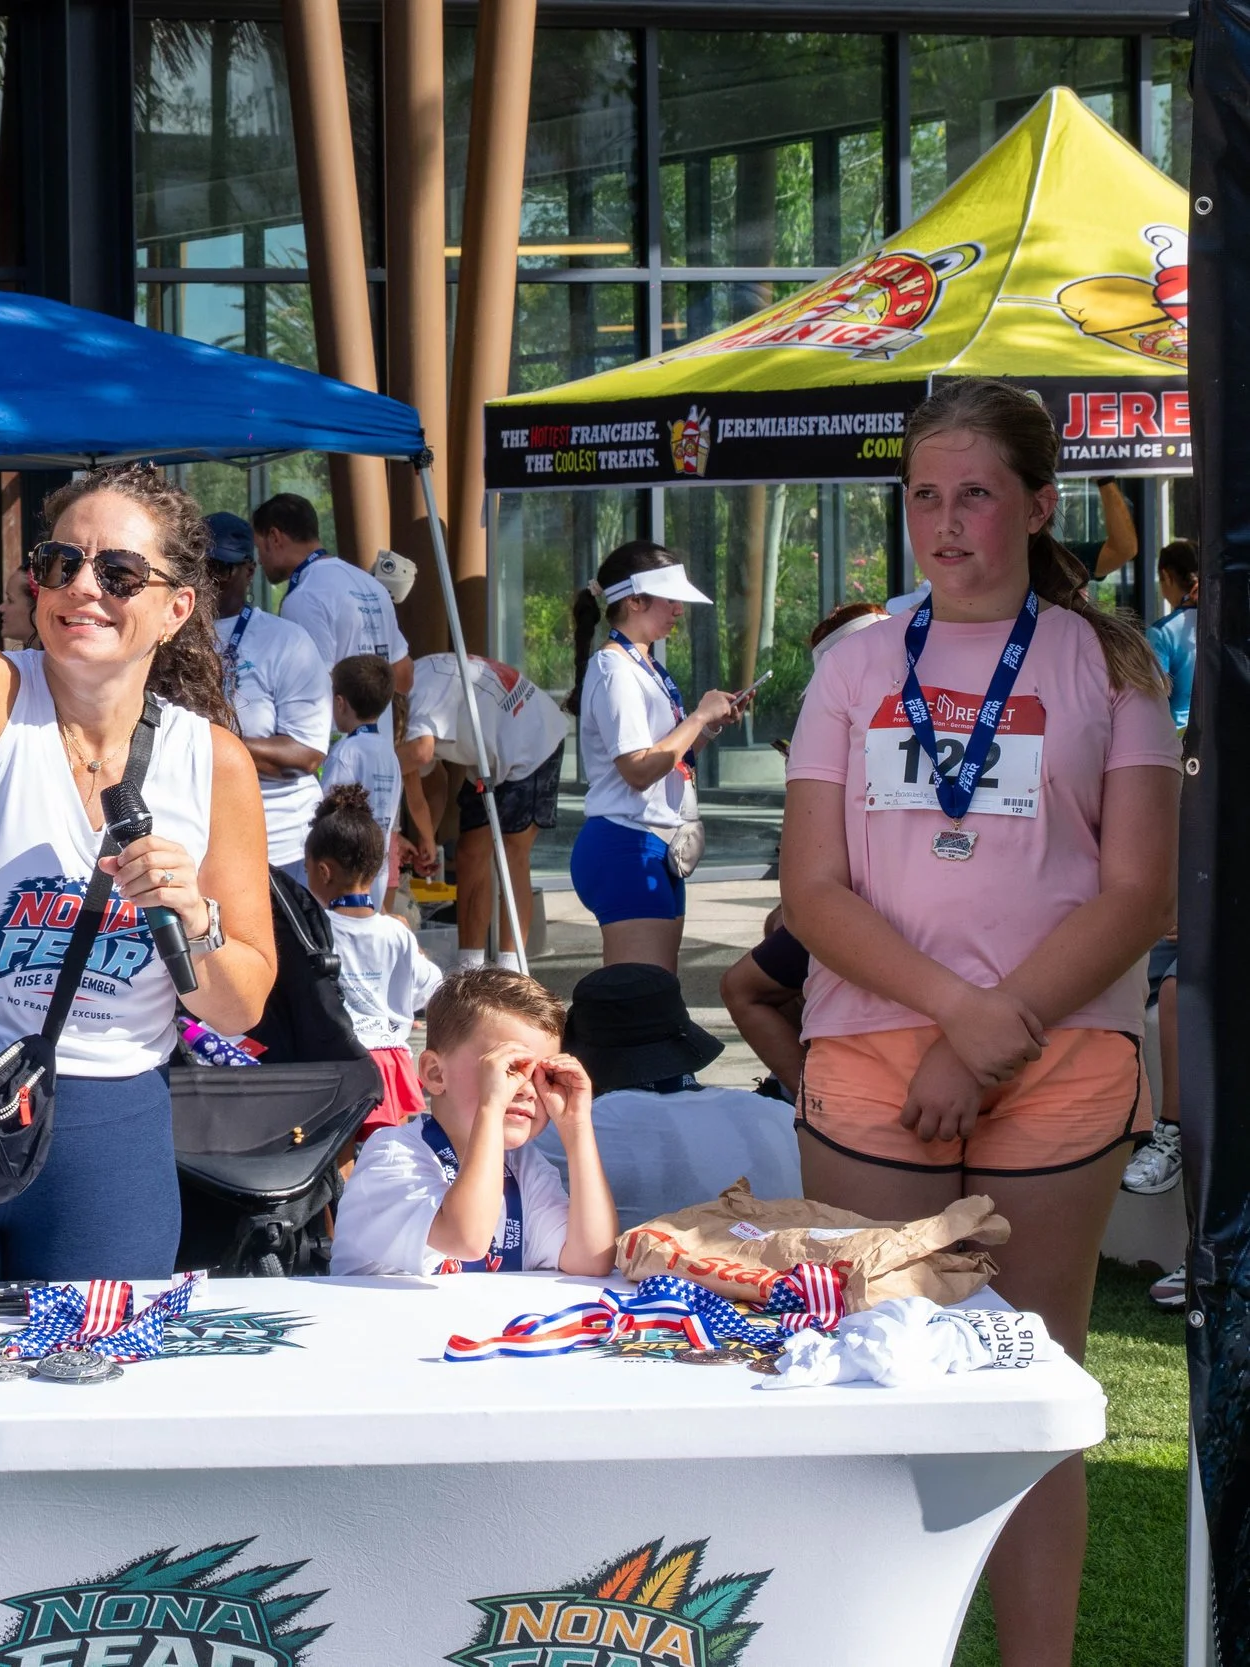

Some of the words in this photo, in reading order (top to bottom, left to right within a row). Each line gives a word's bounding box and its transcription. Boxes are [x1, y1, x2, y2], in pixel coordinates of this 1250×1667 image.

[817, 325, 895, 346] ICE
[501, 429, 529, 448] THE
[530, 425, 570, 449] HOTTEST
[570, 421, 660, 446] FRANCHISE.
[716, 412, 905, 443] JEREMIAHSFRANCHISE
[525, 453, 553, 473] THE
[554, 449, 598, 473] COOLEST
[598, 448, 660, 470] TREATS.
[856, 437, 904, 459] .COM
[1063, 444, 1130, 460] ITALIAN
[1134, 443, 1162, 459] ICE
[1002, 643, 1016, 665] NONA
[1008, 644, 1025, 670] FEAR
[895, 701, 935, 717] RE
[905, 699, 922, 725] FEAR
[914, 698, 928, 722] NONA
[980, 700, 993, 724] NONA
[986, 700, 1003, 729] FEAR
[958, 762, 971, 788] NONA
[963, 762, 980, 794] FEAR
[13, 973, 41, 988] RISE
[43, 973, 53, 985] &
[81, 977, 117, 996] EMBER
[7, 996, 21, 1006] NO
[72, 1010, 114, 1020] EXCUSES.
[504, 1218, 514, 1250] FEAR
[738, 1222, 751, 1233] Your
[686, 1256, 853, 1300] Staps
[163, 1328, 271, 1342] AR
[621, 1342, 691, 1352] RISE
[1015, 1330, 1034, 1369] CLUB
[29, 1591, 261, 1643] NONA
[500, 1600, 696, 1667] NONA
